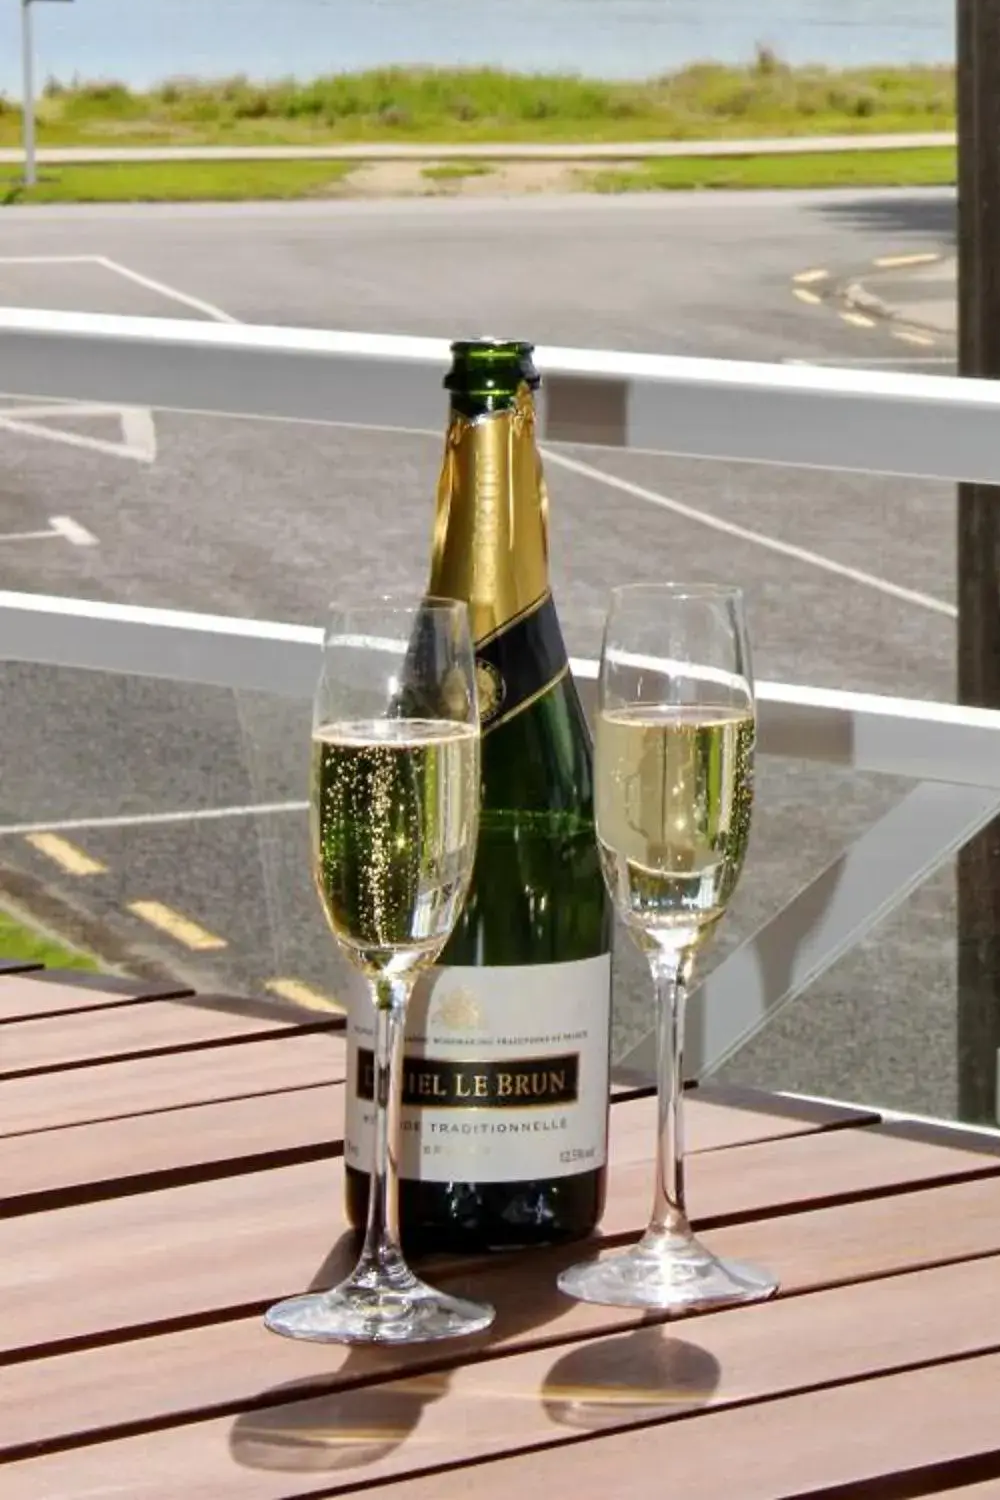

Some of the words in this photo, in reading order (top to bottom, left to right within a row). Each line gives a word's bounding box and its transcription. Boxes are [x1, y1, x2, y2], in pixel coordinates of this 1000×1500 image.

[455, 1073, 488, 1097] LE
[496, 1069, 565, 1097] BRUN
[430, 1118, 567, 1135] TRADITIONNELLE
